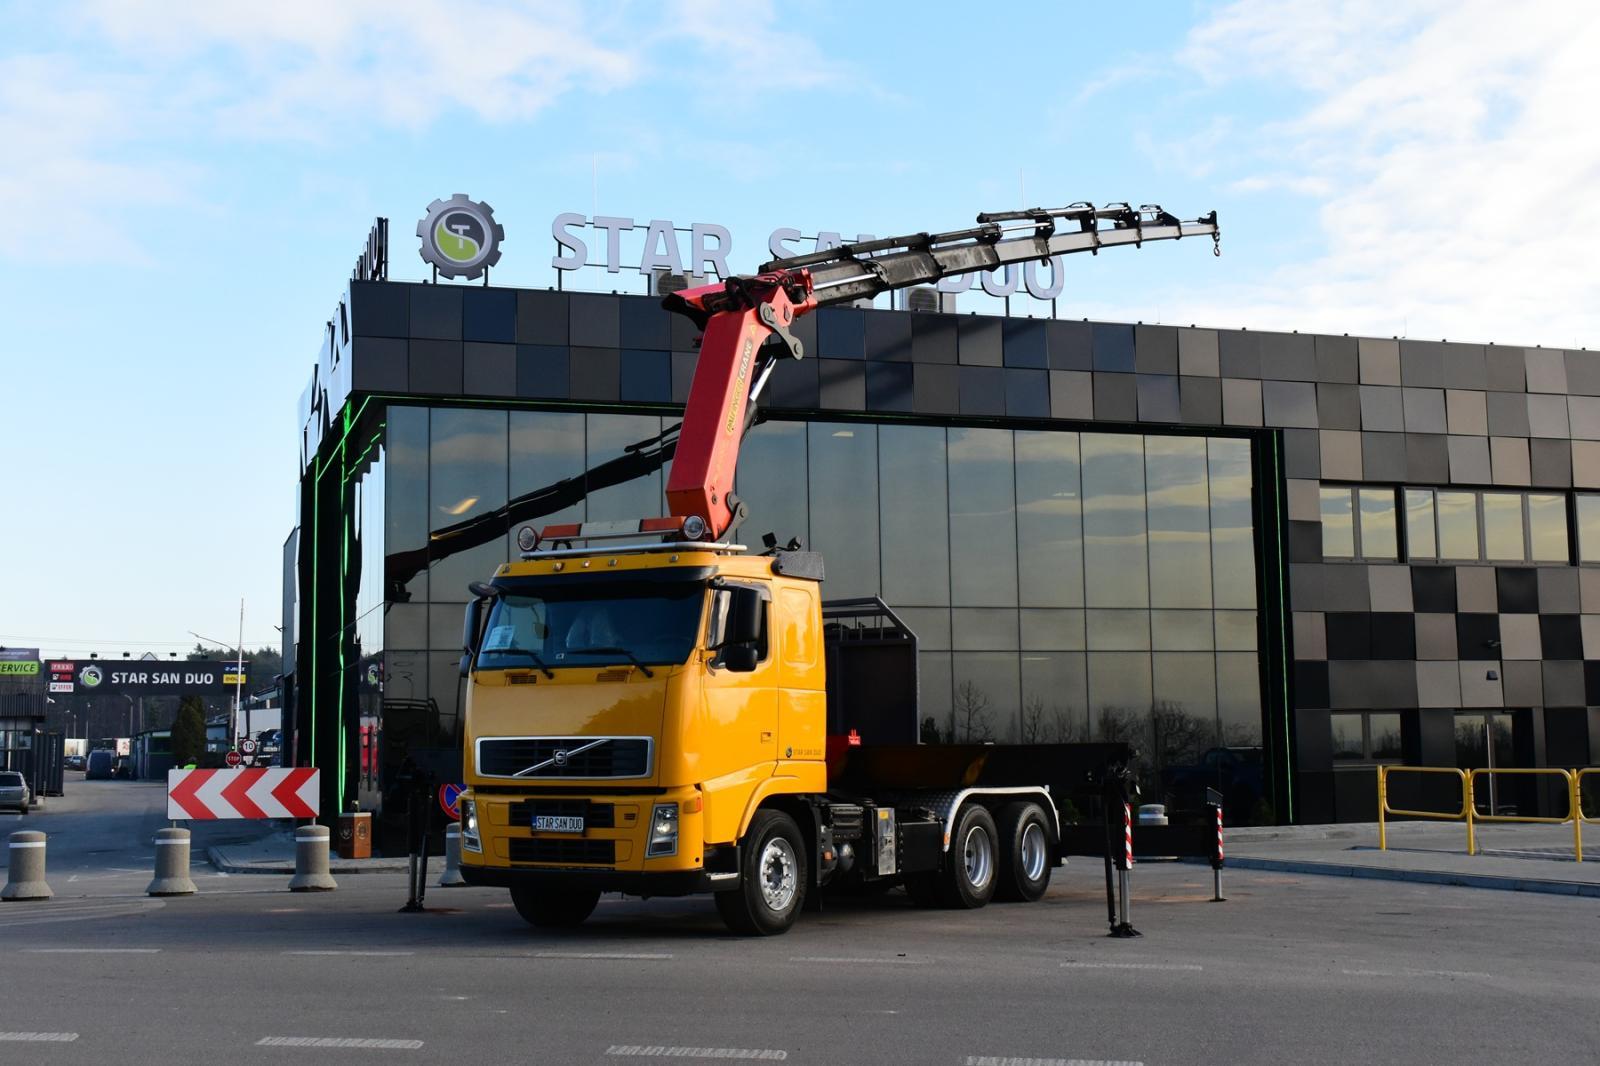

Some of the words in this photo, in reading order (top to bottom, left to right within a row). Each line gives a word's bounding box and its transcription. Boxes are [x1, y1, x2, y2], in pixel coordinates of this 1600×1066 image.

[551, 212, 732, 279] STAR
[740, 338, 753, 379] CRANE
[0, 663, 36, 672] ERVICE
[111, 672, 148, 684] STAR
[152, 672, 180, 684] SAN
[185, 673, 214, 685] DUO
[245, 741, 254, 750] 10
[537, 817, 553, 829] STAR
[555, 817, 568, 829] SAN
[569, 818, 583, 830] DUO
